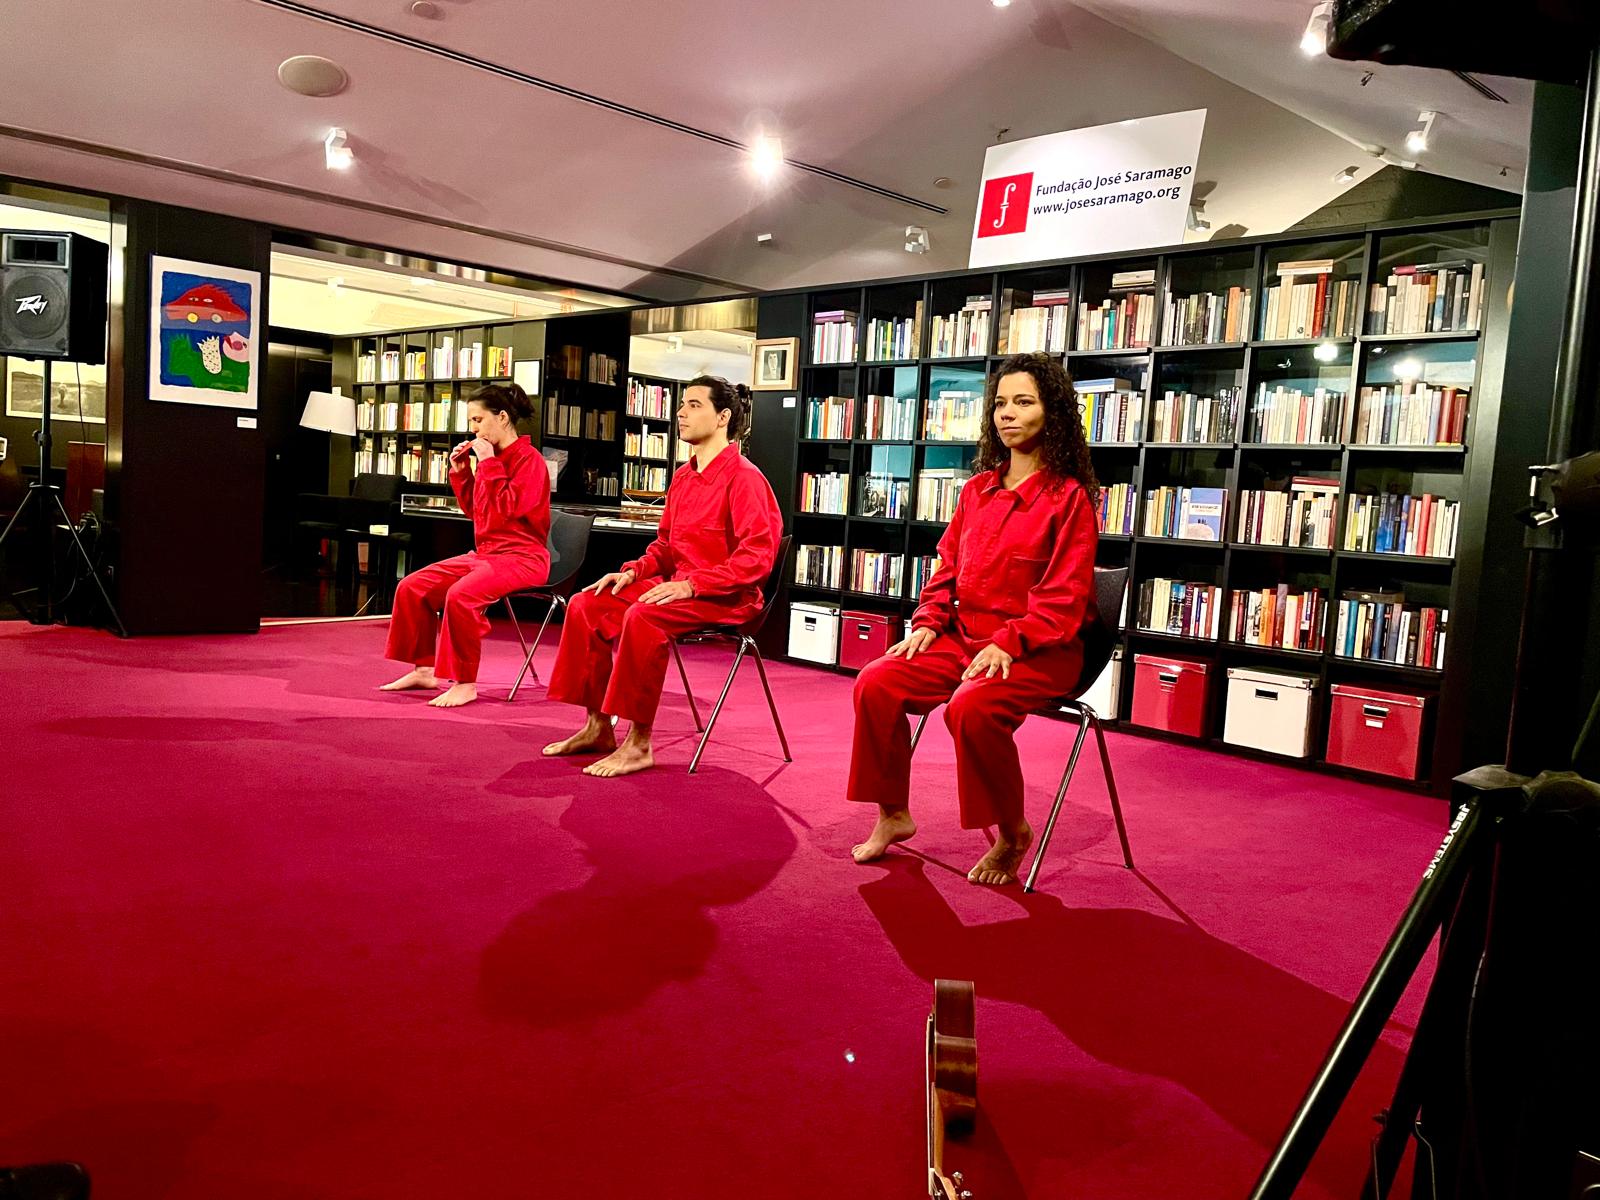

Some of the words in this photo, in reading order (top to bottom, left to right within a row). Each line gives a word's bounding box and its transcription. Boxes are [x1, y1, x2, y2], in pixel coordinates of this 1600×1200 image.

[1036, 177, 1092, 196] Fundação
[1095, 172, 1122, 190] José
[1125, 164, 1192, 182] Saramago
[1033, 185, 1181, 214] www.josesaramago.org
